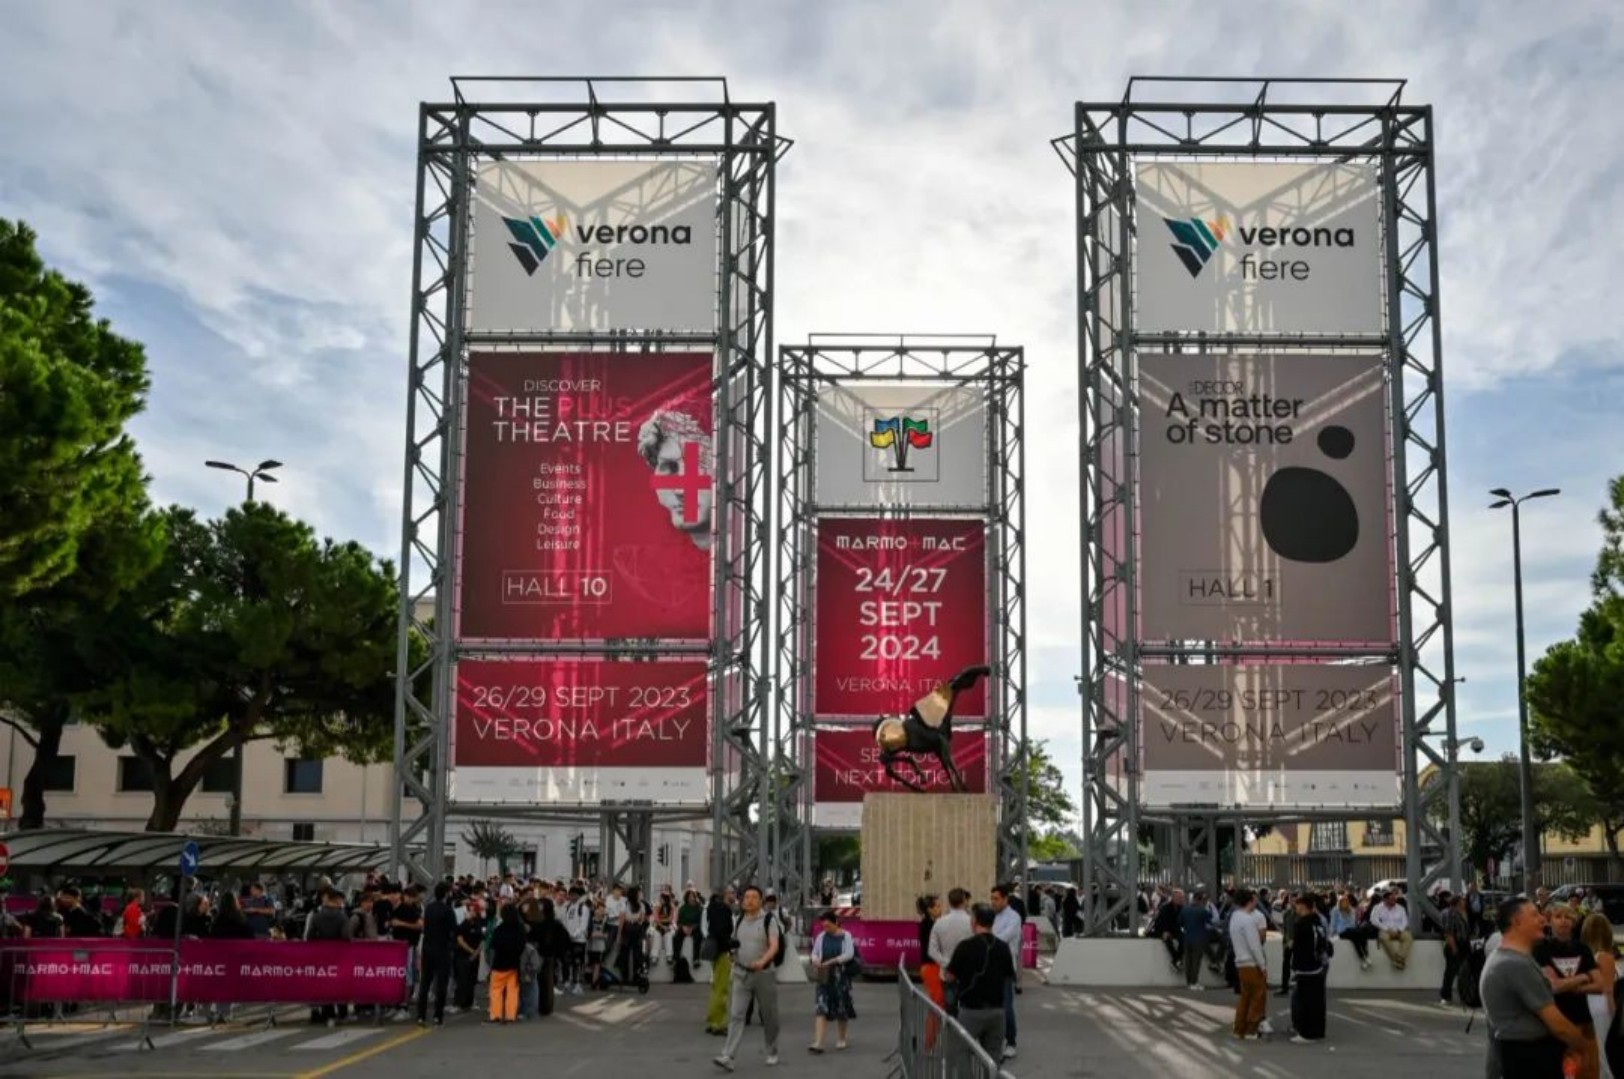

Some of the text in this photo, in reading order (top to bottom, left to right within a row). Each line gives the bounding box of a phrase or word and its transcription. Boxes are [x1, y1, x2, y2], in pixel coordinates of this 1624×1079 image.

[577, 225, 691, 244] verona
[1239, 227, 1354, 246] verona
[576, 252, 645, 277] fiere
[1240, 254, 1309, 280] fiere
[524, 380, 600, 391] DISCOVER
[493, 397, 631, 418] THE PLUS
[1165, 392, 1303, 418] A matter
[493, 421, 632, 442] THEATRE
[1166, 418, 1293, 444] of stone
[540, 463, 581, 474] Events
[533, 478, 586, 489] Business
[538, 493, 582, 504] Culture
[543, 507, 575, 519] Food
[538, 523, 580, 537] Design
[537, 539, 580, 550] Leisure
[507, 577, 607, 596] HALL 10
[855, 564, 947, 597] 24/27
[1190, 579, 1273, 598] HALL 1
[860, 601, 942, 626] SEPT
[860, 635, 941, 660] 2024
[473, 686, 691, 708] 26/29 SEPT 2023
[1160, 689, 1378, 711] 26/29 SEPT 2023
[473, 718, 691, 740] VERONA ITALY
[1160, 722, 1378, 743] VERONA ITALY
[835, 769, 886, 785] NEXT
